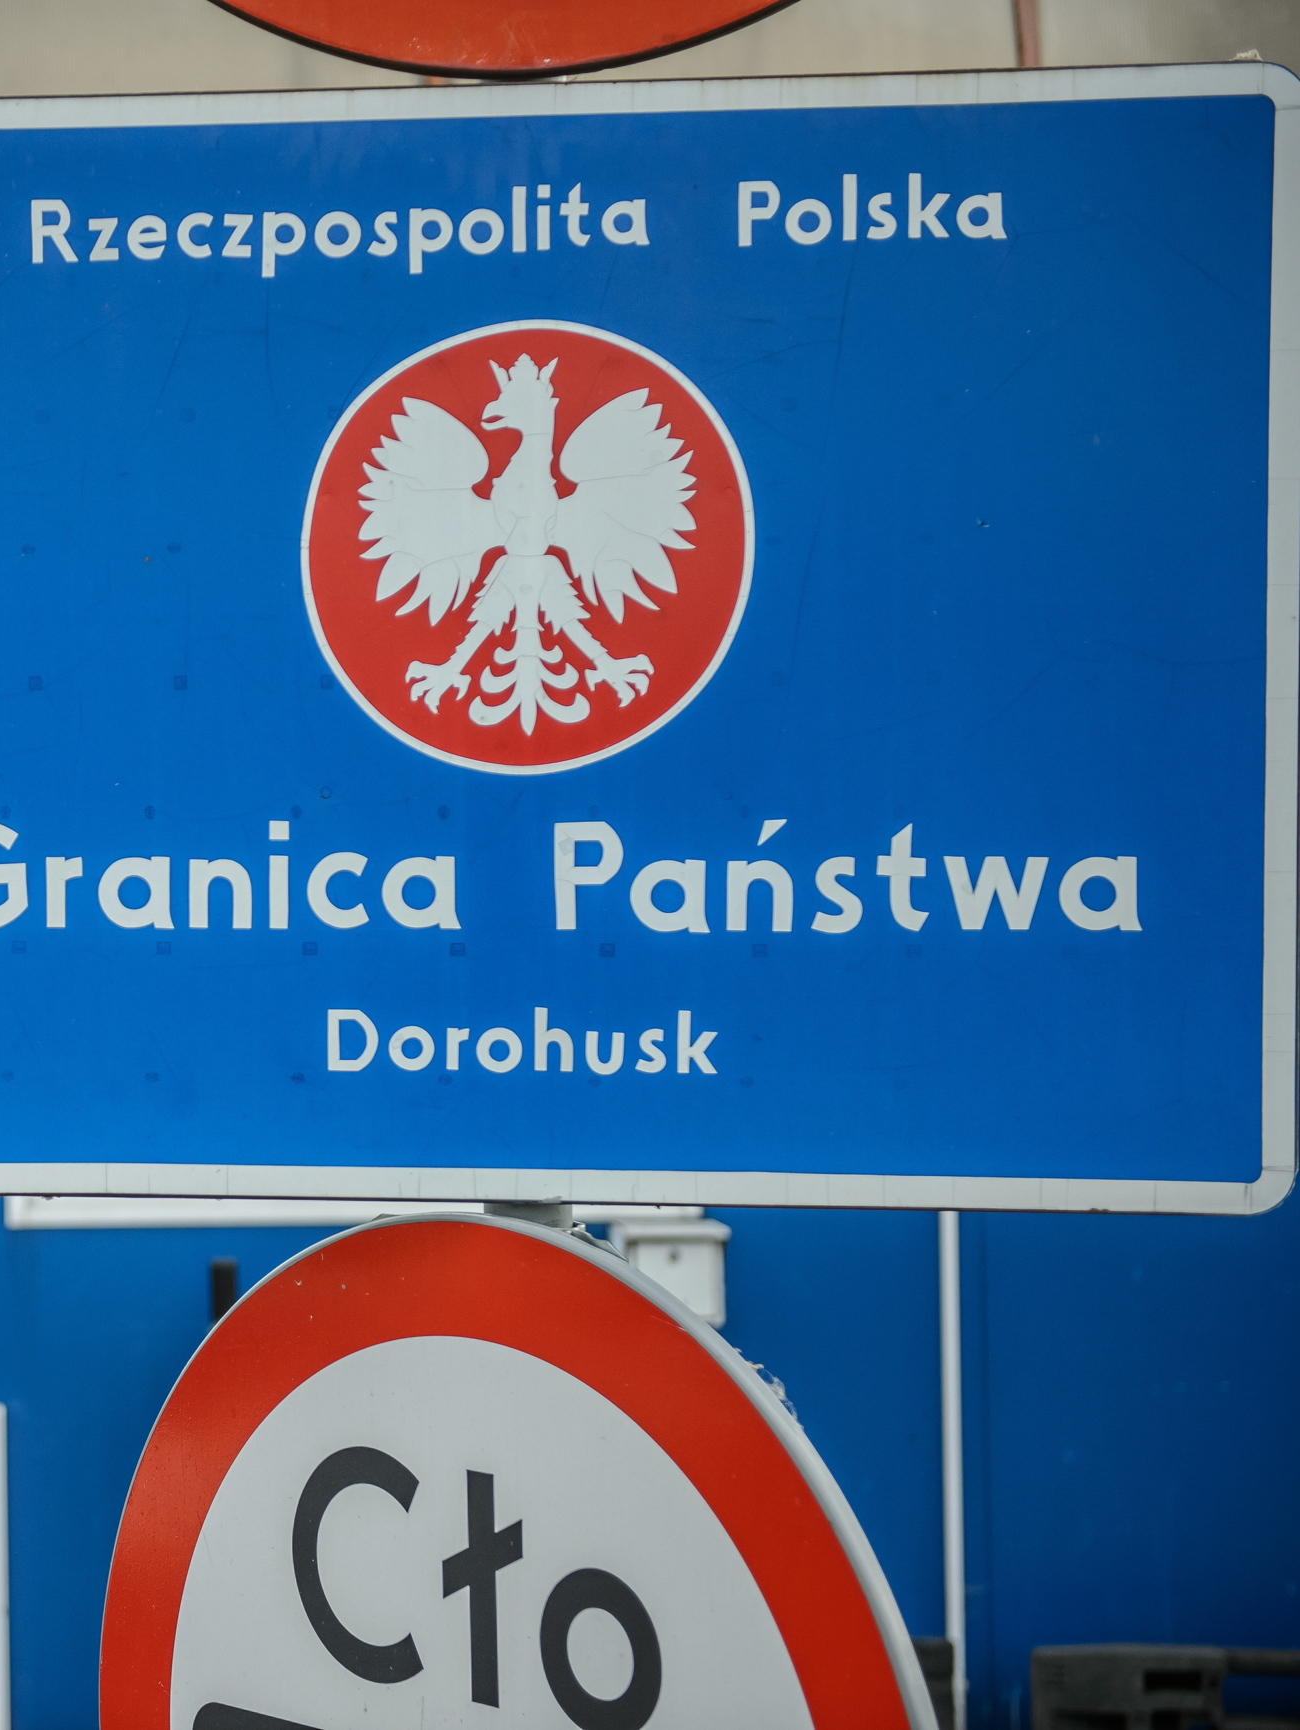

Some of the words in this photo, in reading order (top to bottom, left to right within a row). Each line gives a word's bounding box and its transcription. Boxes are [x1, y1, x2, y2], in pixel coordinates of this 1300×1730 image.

[31, 183, 650, 278] Rzeczpospolita
[738, 172, 1007, 247] Polska
[554, 818, 1143, 934] Państwa
[327, 1006, 718, 1075] Dorohusk
[291, 1445, 663, 1730] Cło
